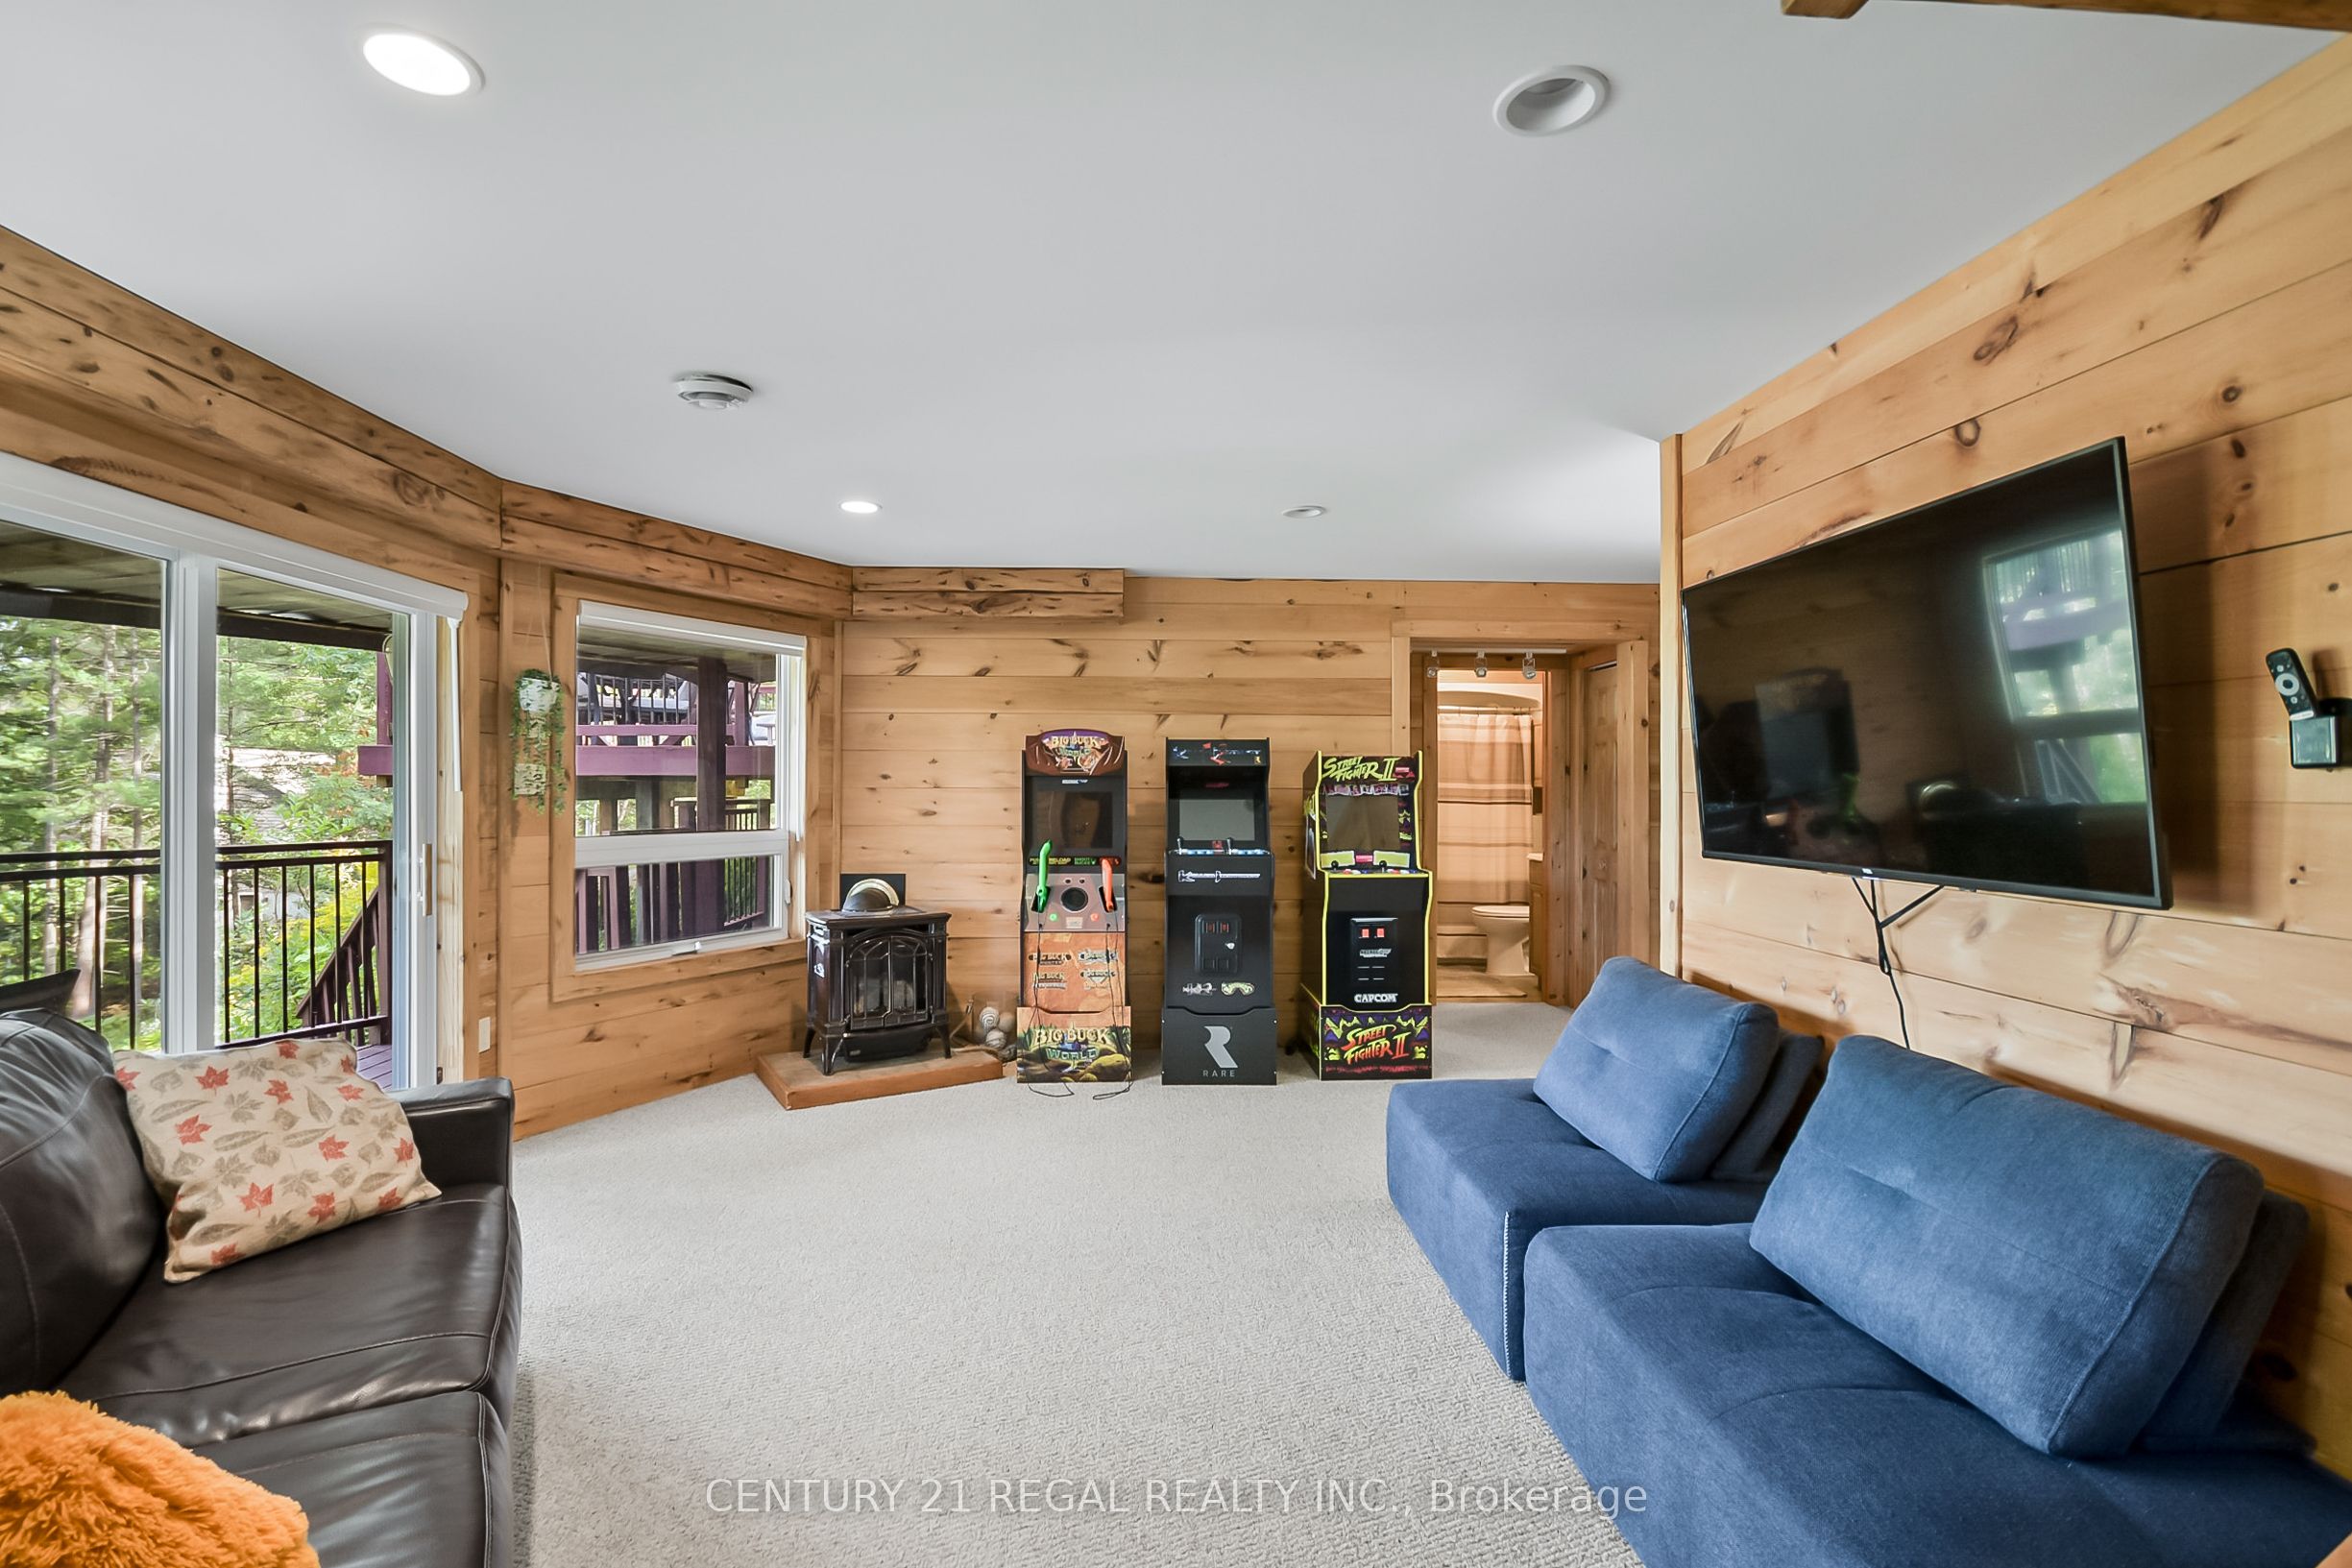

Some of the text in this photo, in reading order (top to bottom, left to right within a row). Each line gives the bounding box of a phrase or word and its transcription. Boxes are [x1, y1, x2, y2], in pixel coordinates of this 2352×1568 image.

[1321, 756, 1364, 778] STREET
[1329, 757, 1401, 782] FIGHTER II
[1354, 993, 1398, 1003] CAPCOM
[1033, 1027, 1112, 1045] BIG BUCK
[1341, 1024, 1397, 1051] STREET
[1045, 1048, 1099, 1061] WORLD
[1344, 1031, 1412, 1065] FIGHTER II
[1202, 1069, 1236, 1078] RARE
